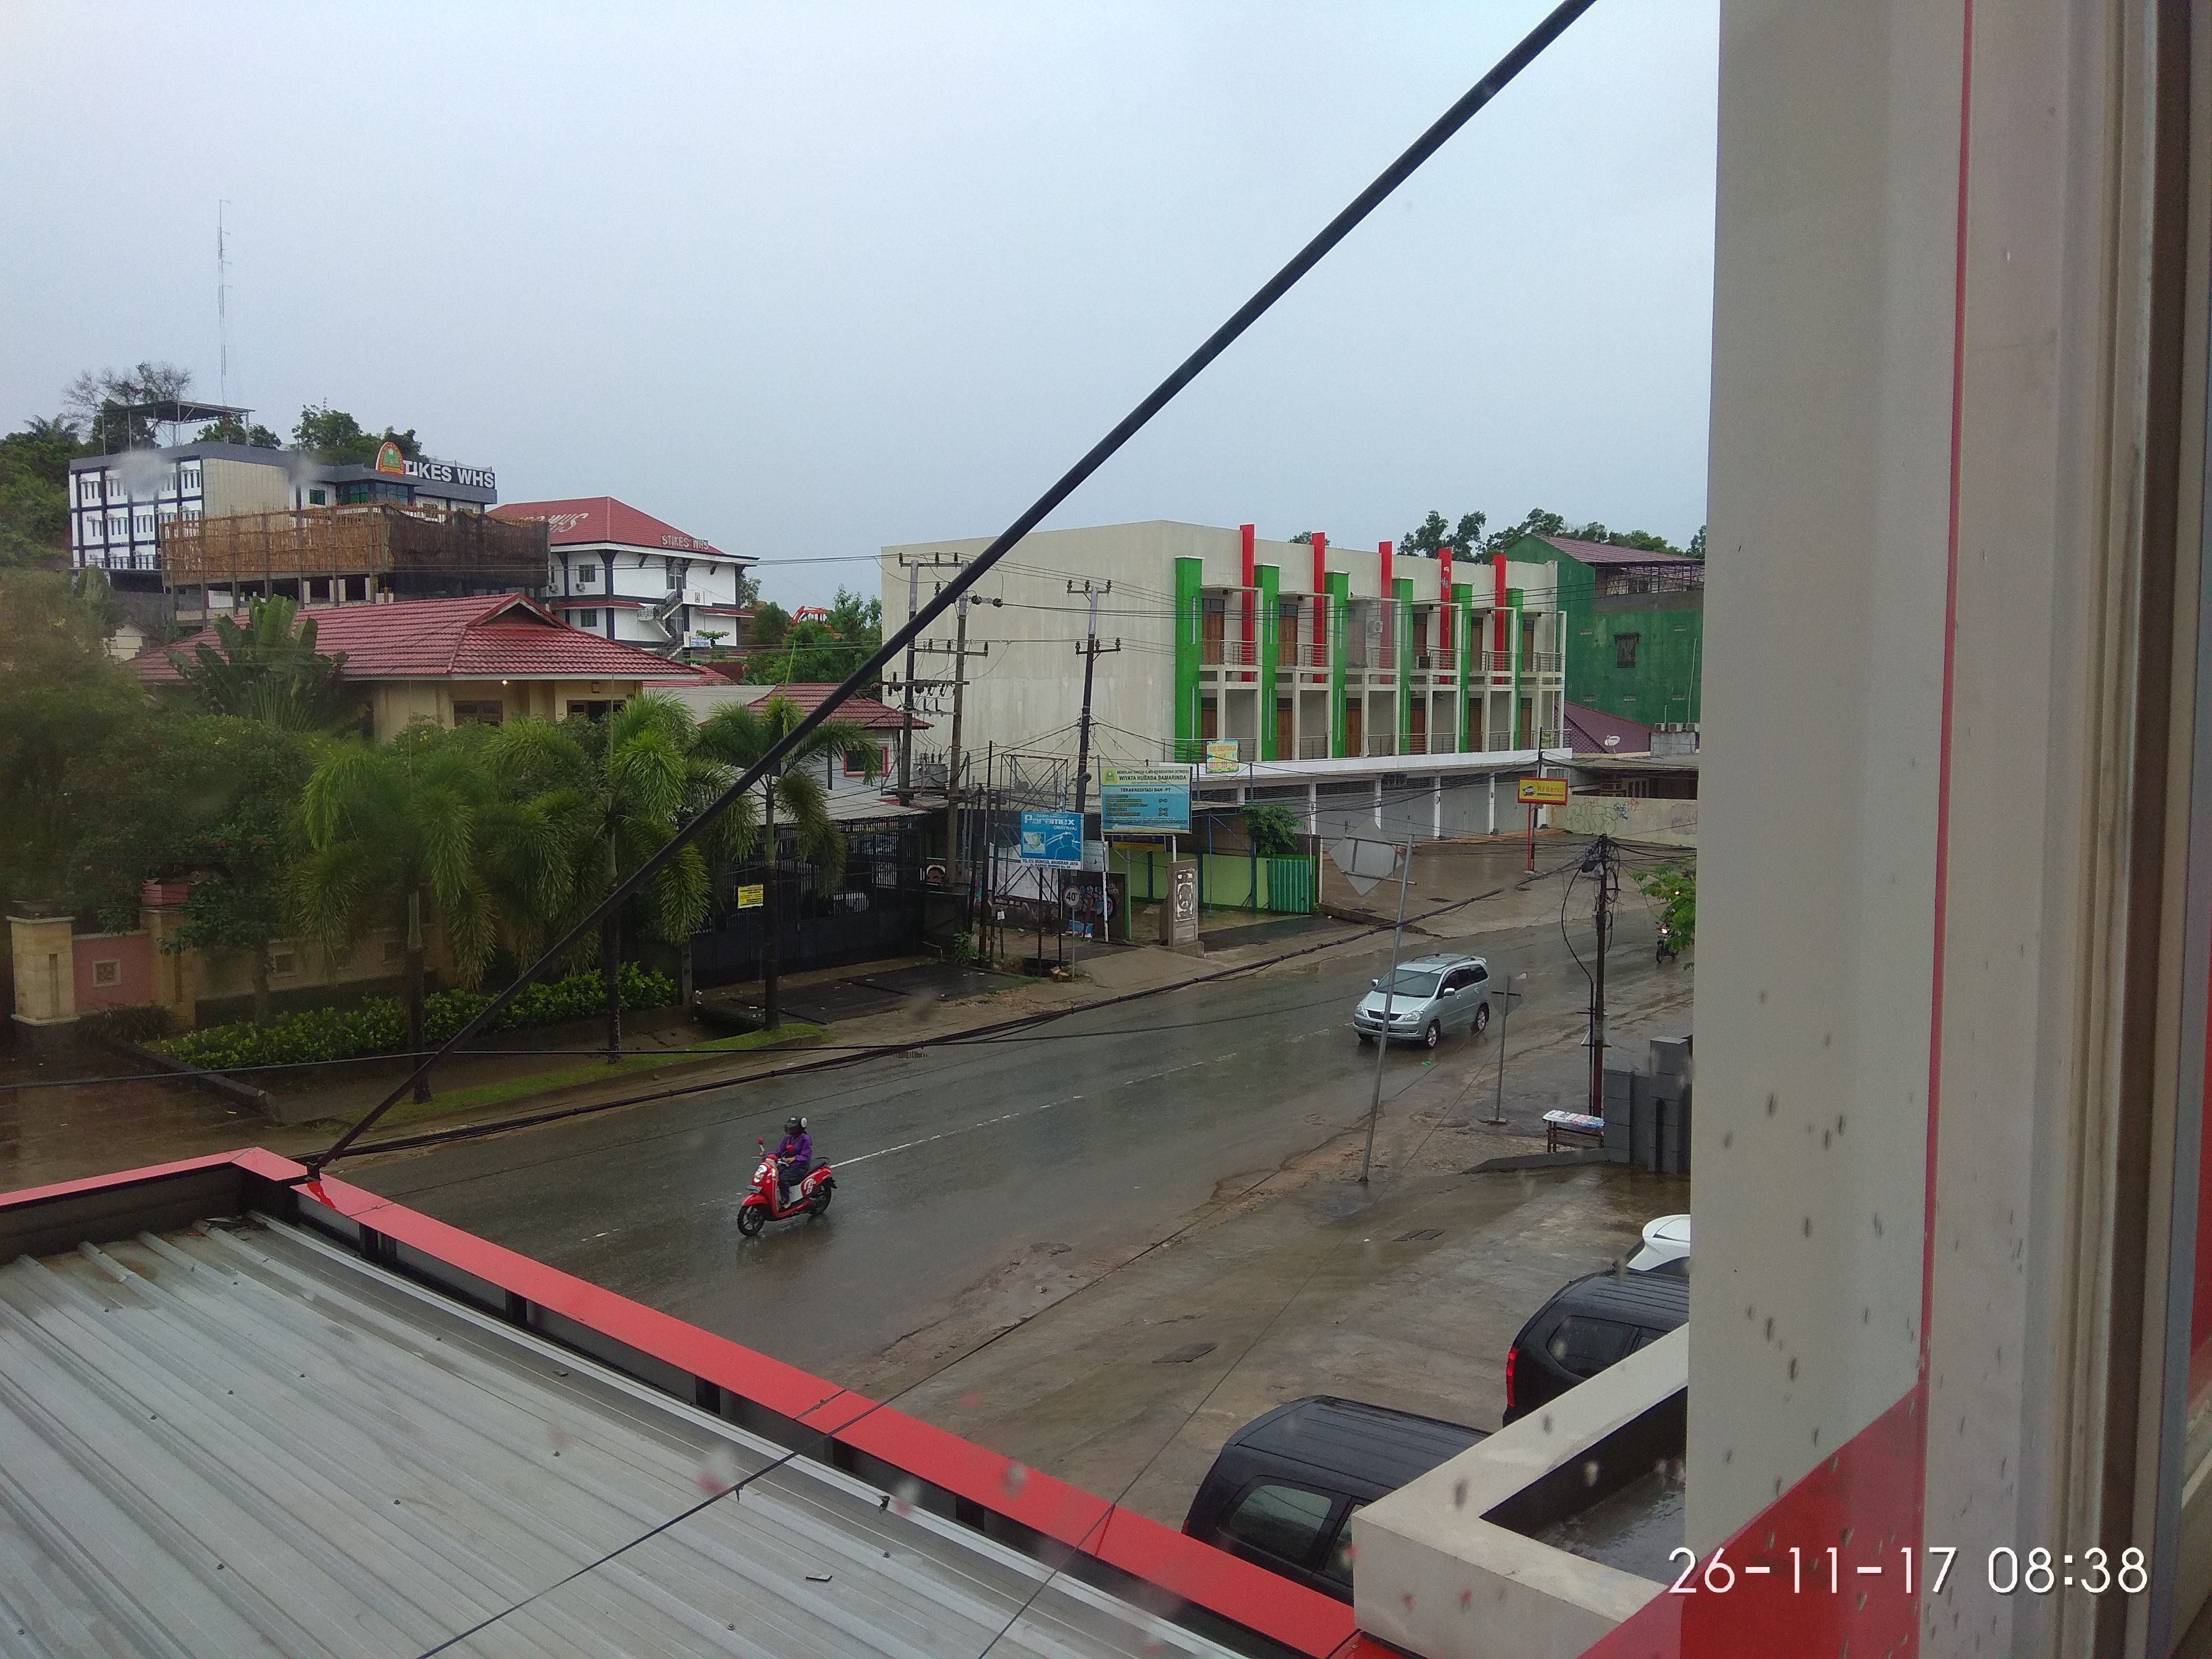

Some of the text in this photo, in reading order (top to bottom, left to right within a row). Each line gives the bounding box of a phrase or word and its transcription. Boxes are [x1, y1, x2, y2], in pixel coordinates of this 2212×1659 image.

[404, 460, 495, 488] TIKES WHS
[661, 535, 709, 550] STIKES WHS
[1025, 814, 1075, 825] Paramex
[1066, 892, 1075, 901] 40
